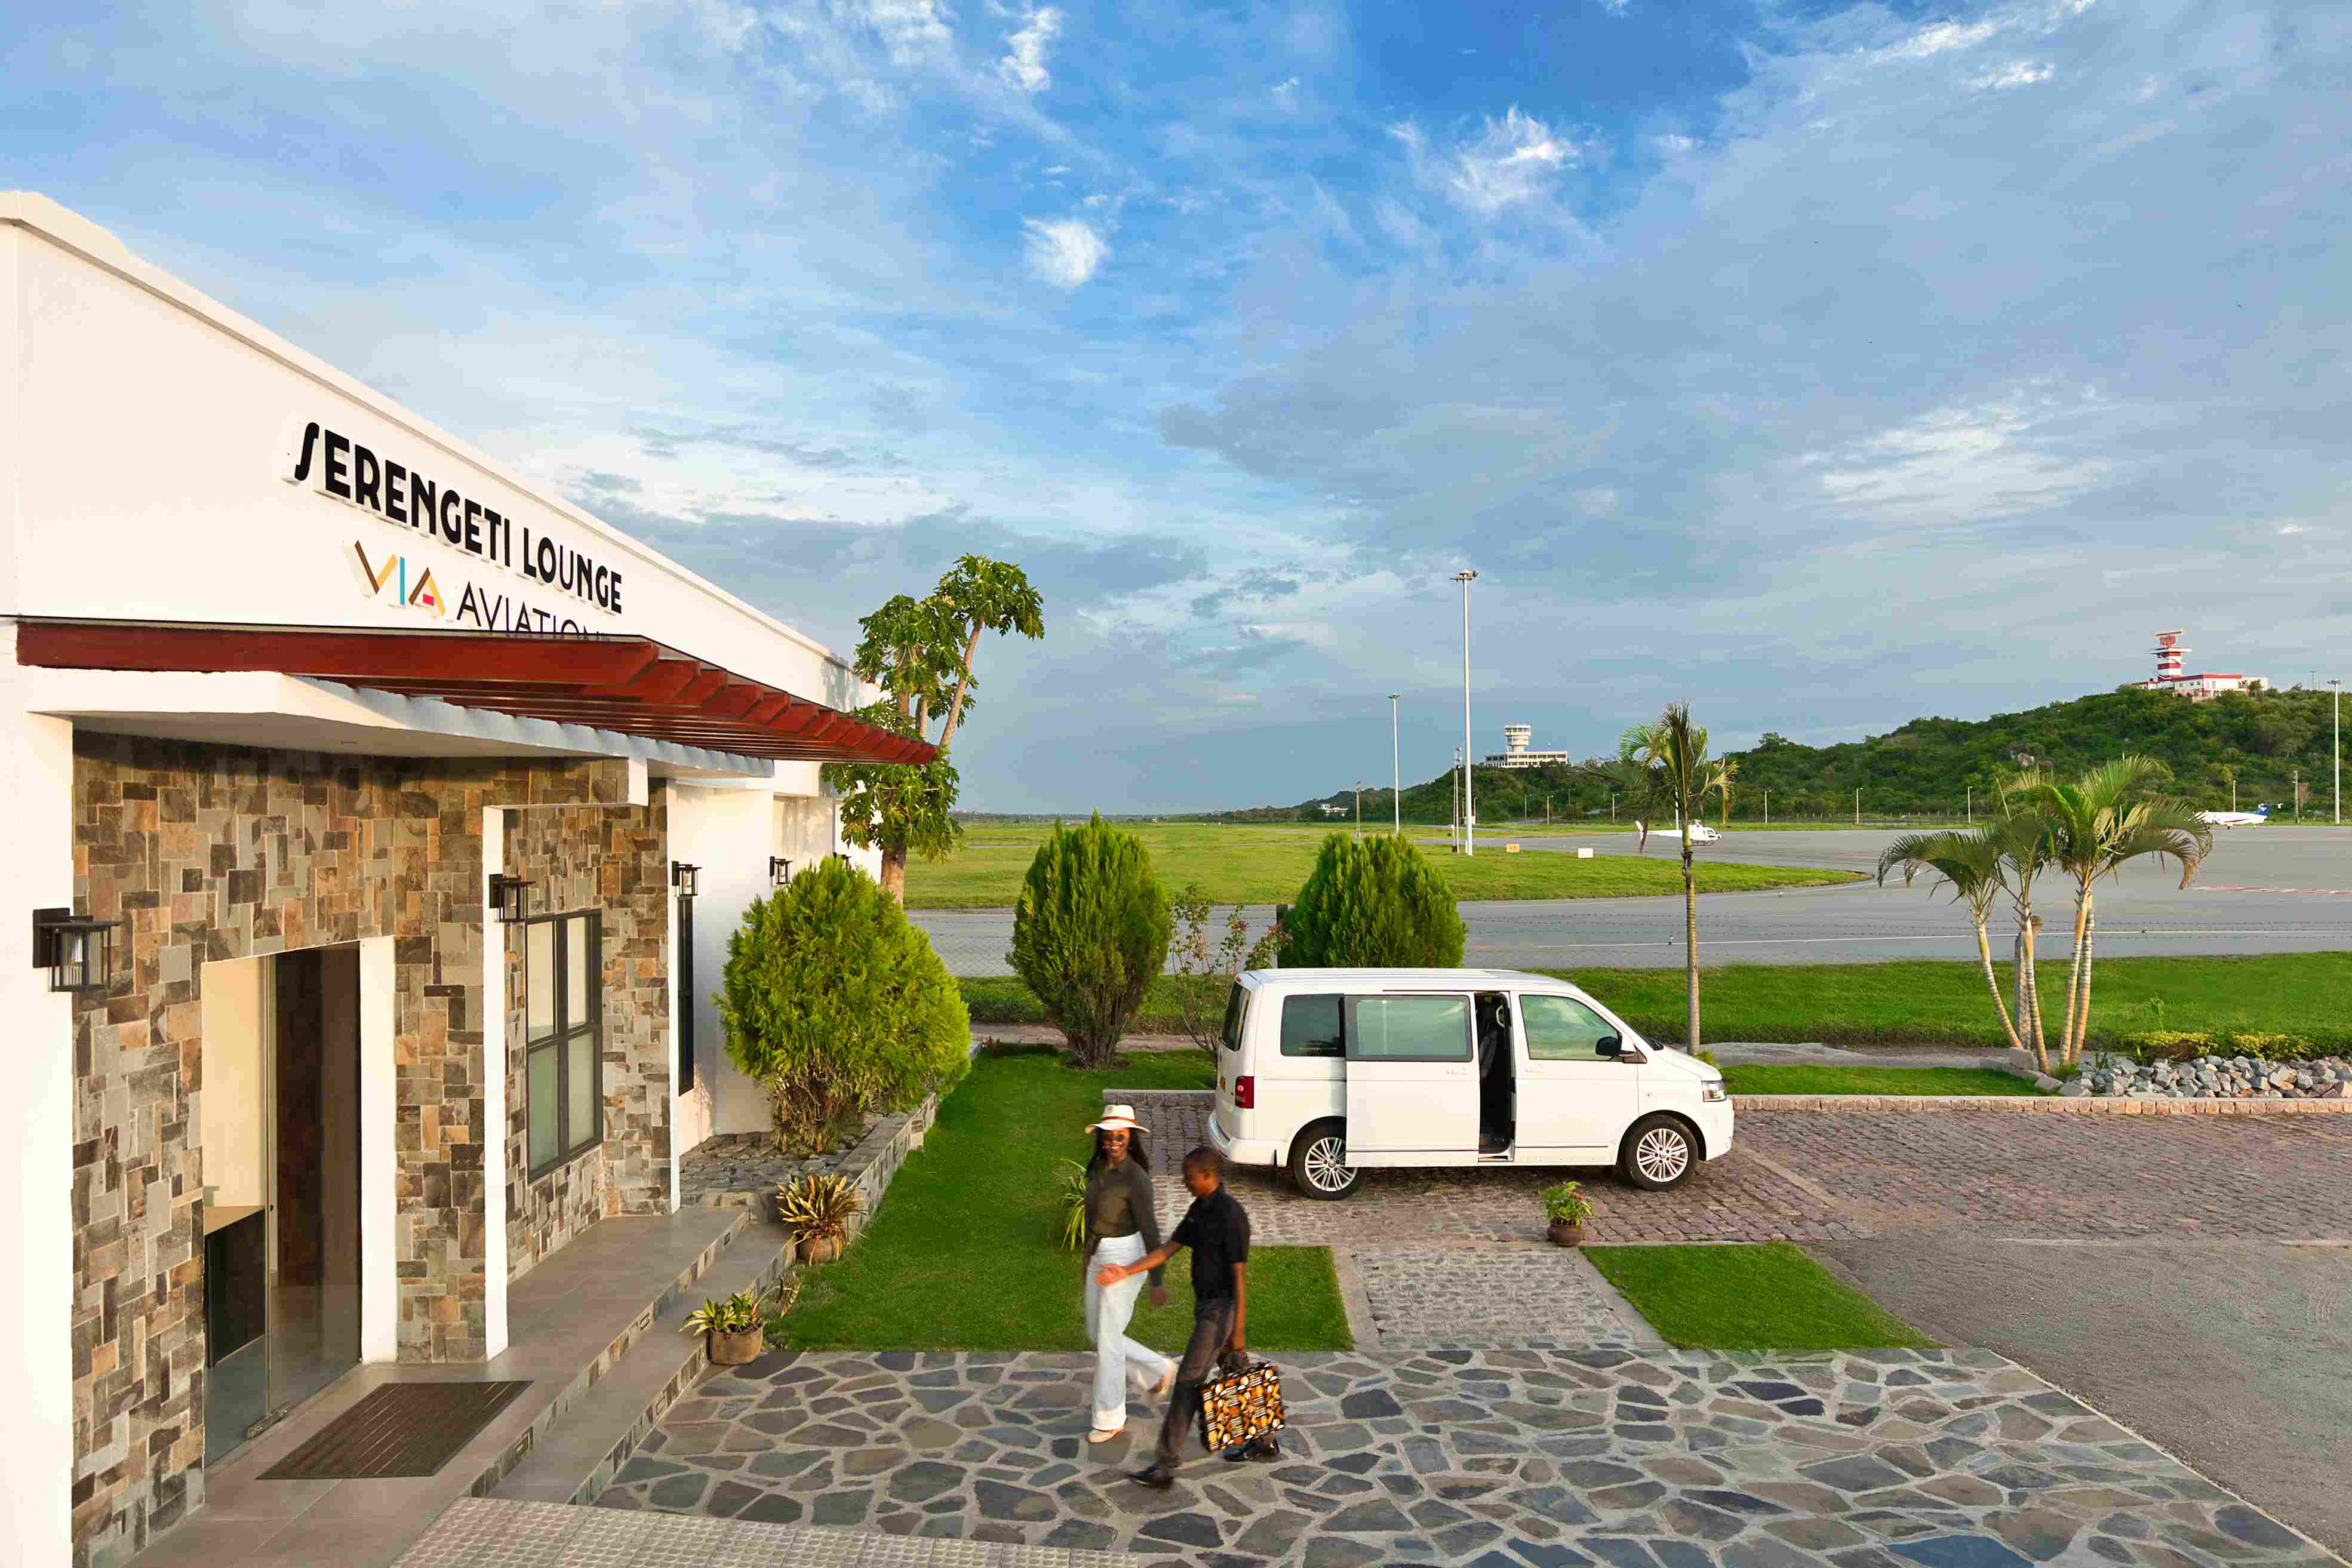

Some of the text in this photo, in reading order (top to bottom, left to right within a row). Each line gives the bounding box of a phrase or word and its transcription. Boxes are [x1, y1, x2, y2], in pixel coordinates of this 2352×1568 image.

[294, 422, 622, 614] SERENGETI LOUNGE
[354, 540, 601, 635] VIA AVIATI
